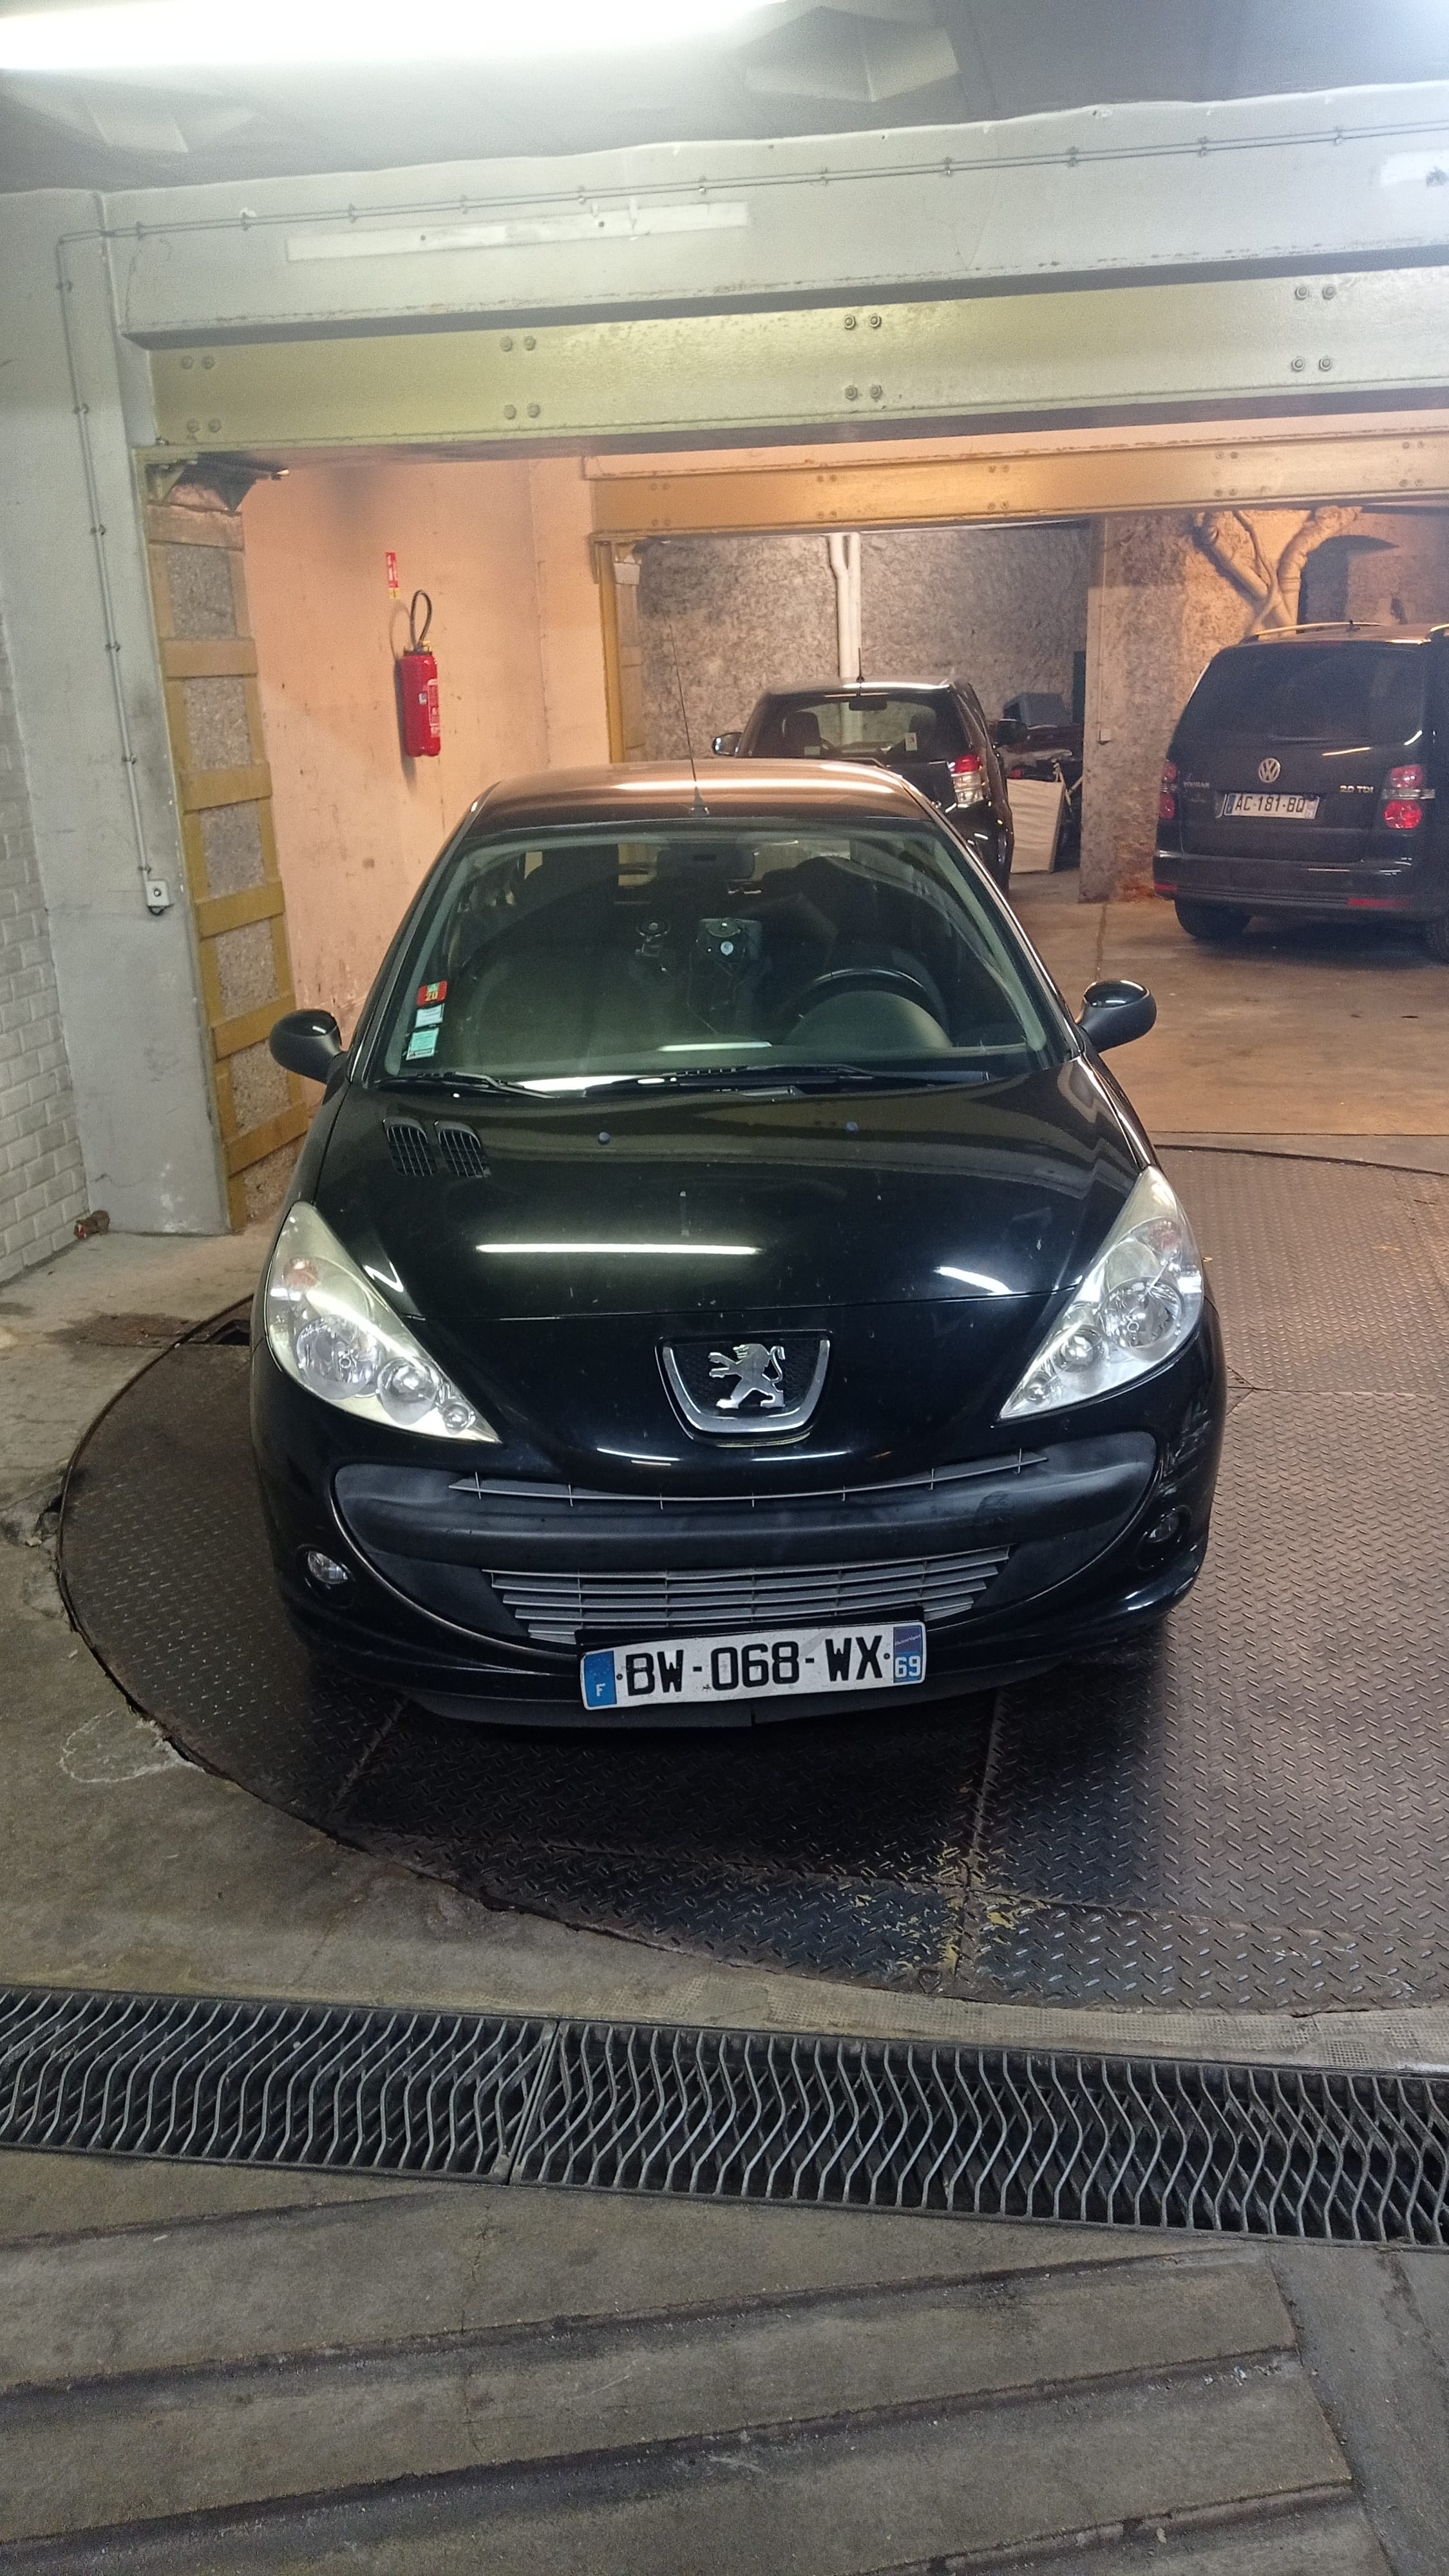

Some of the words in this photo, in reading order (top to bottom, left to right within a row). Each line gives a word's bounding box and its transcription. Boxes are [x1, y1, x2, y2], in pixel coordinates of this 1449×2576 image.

[1258, 757, 1281, 783] VW
[625, 1634, 884, 1696] BW-068-WX
[895, 1655, 922, 1678] 69
[596, 1683, 606, 1697] F
